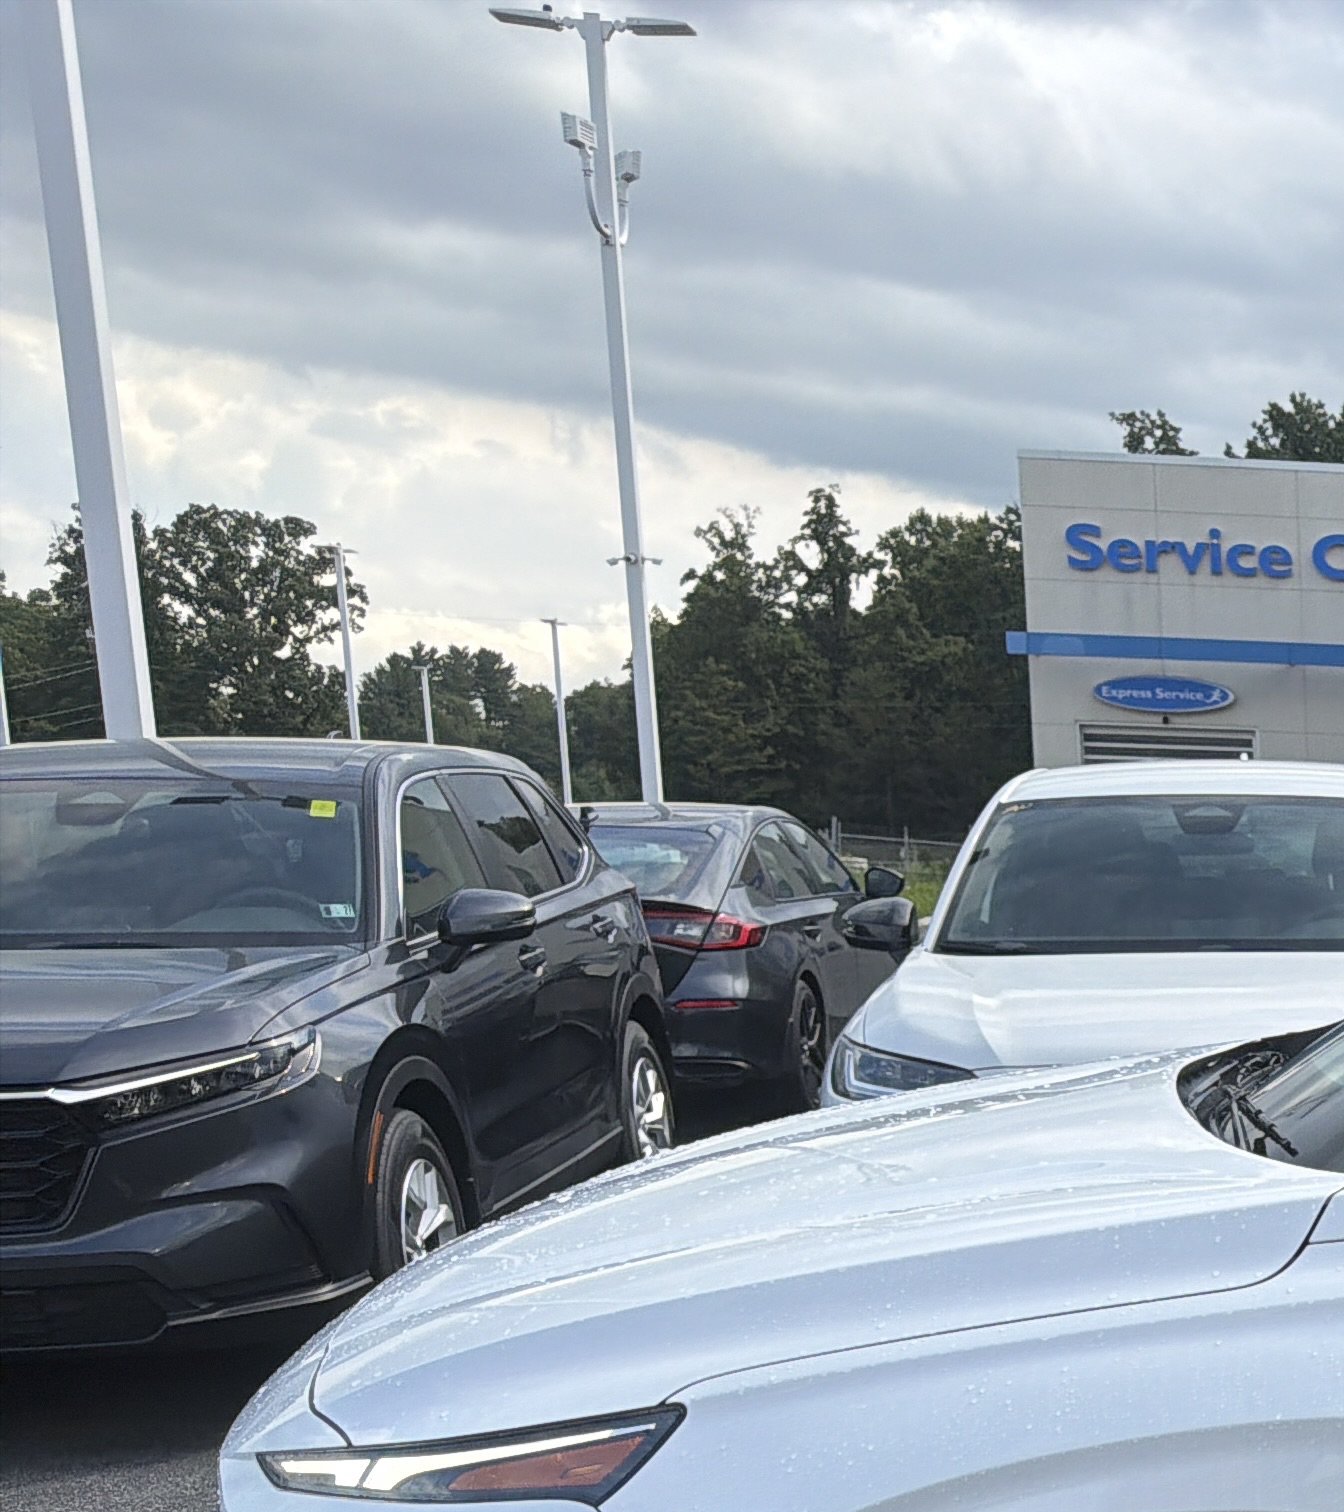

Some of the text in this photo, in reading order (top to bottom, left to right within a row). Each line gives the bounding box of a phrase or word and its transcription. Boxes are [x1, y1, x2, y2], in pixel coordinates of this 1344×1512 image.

[1064, 522, 1293, 578] Service
[1101, 686, 1206, 701] Express Service
